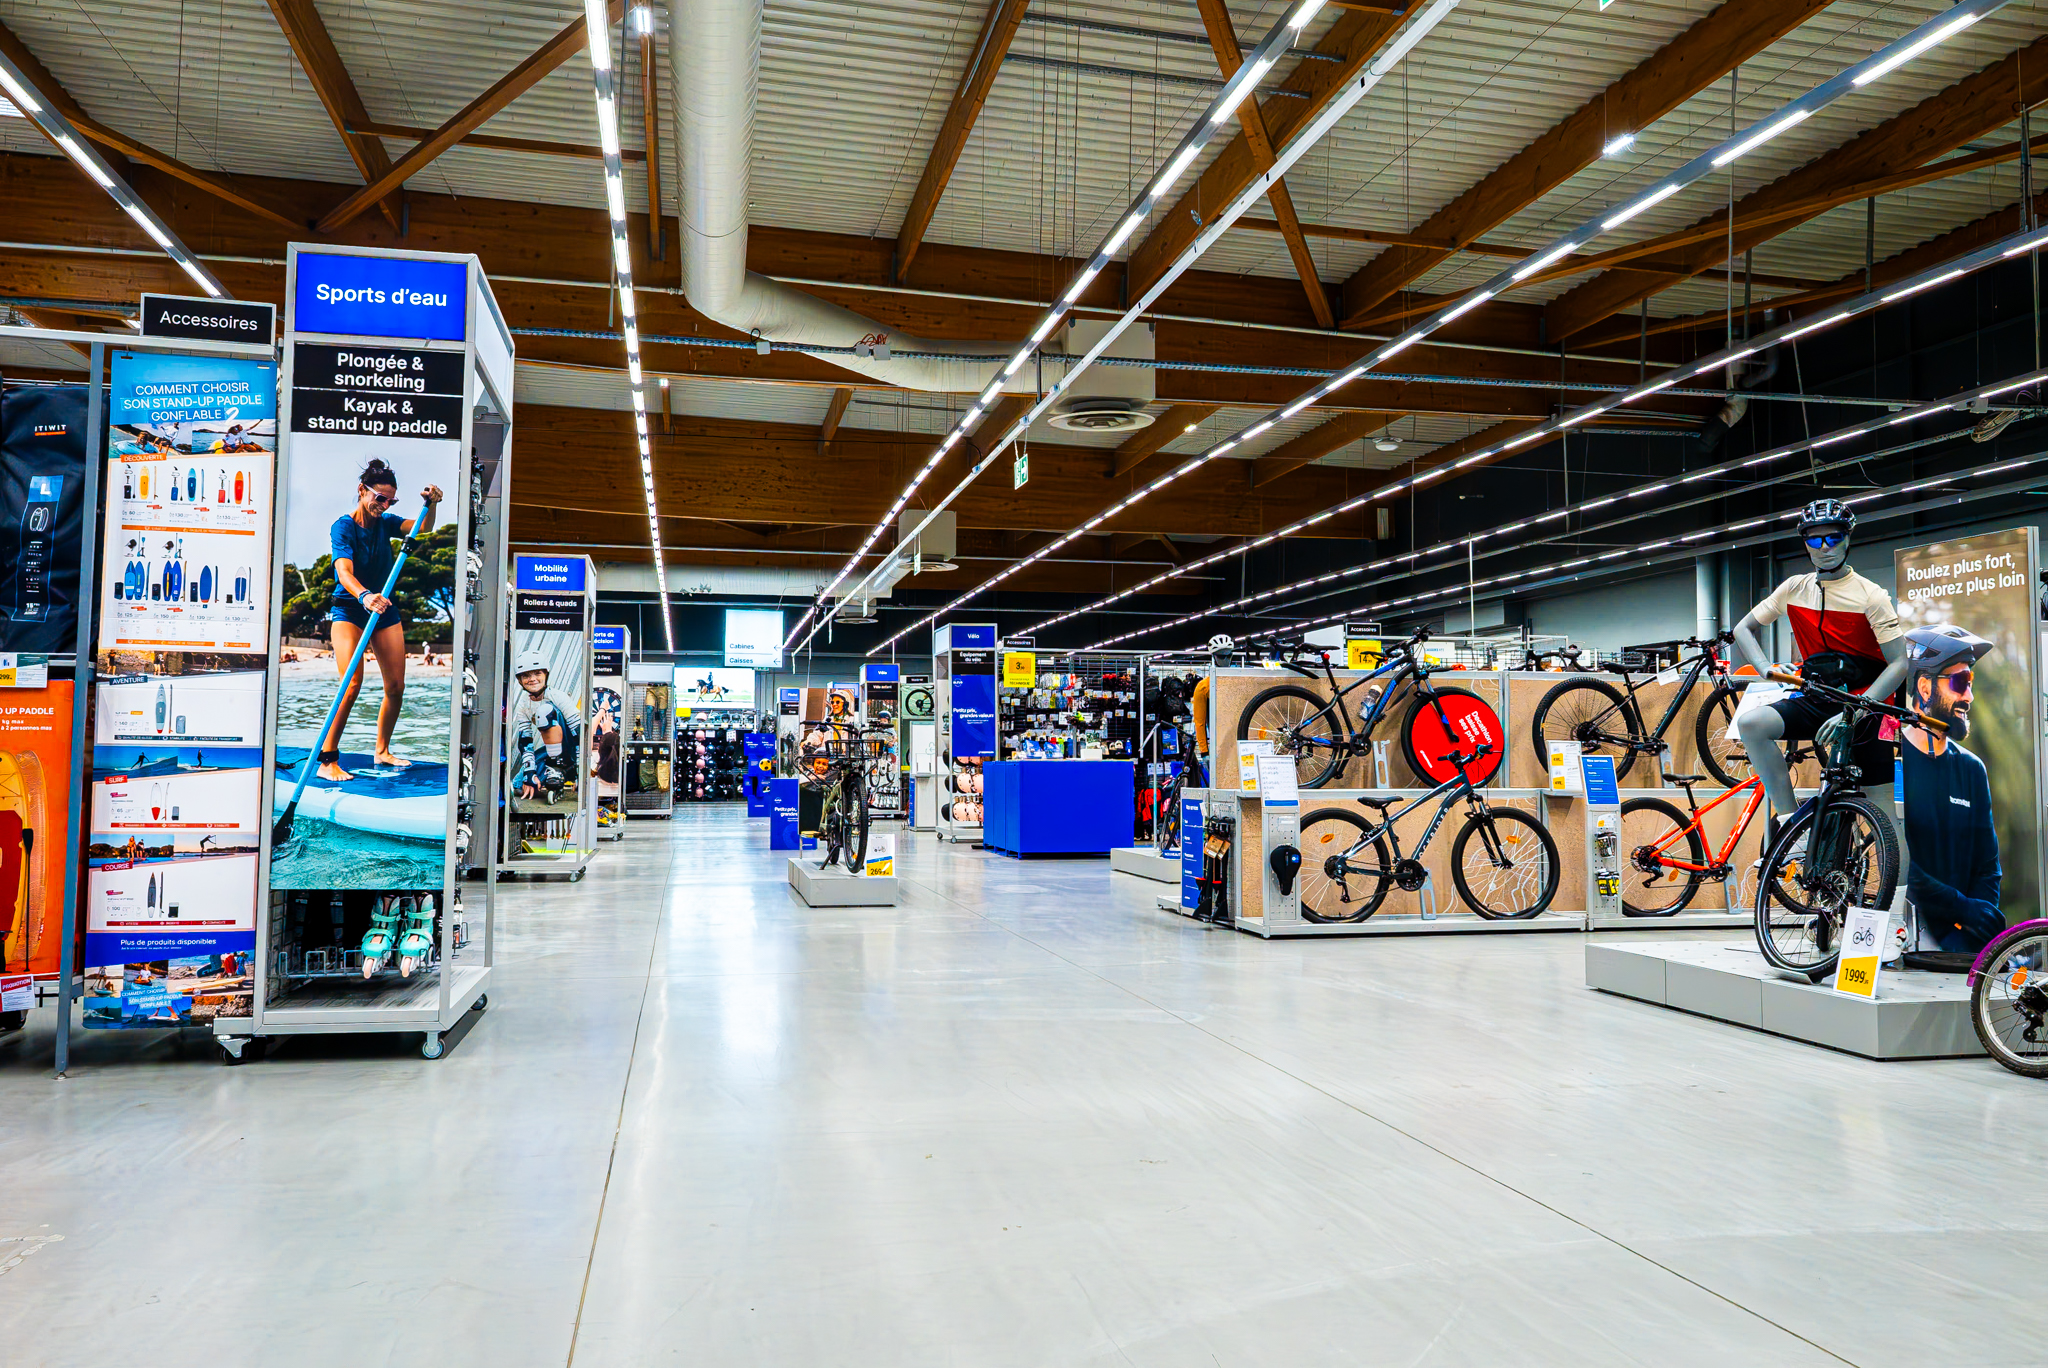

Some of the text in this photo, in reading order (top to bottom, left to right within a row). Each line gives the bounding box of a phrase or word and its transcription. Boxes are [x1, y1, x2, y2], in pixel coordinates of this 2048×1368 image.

[316, 283, 447, 307] Sports d'eau
[159, 310, 258, 331] Accessoires
[337, 353, 424, 372] Plongée &
[135, 382, 250, 396] COMMENT CHOISIR
[334, 373, 425, 392] snorkeling
[124, 394, 262, 410] SON STAND-UP PADDLE
[344, 397, 414, 415] Kayak &
[151, 409, 222, 421] GONFLABLE
[34, 424, 67, 432] ITIWIT
[308, 416, 447, 436] stand up paddle
[40, 483, 51, 495] L
[534, 563, 569, 573] Mobilité
[1906, 552, 2016, 582] Roulez plus fort,
[534, 574, 568, 583] urbaine
[1907, 570, 2025, 600] explorez plus loin
[523, 598, 548, 607] Rollers
[555, 599, 577, 608] quads
[529, 617, 570, 625] Skateboard
[960, 651, 987, 659] Équipement
[112, 676, 145, 685] AVENTURE
[5, 707, 55, 715] UP PADDLE
[1458, 718, 1476, 744] ses prix
[1465, 714, 1480, 736] baisse
[1471, 710, 1492, 744] Decathlon
[109, 776, 125, 784] SURF
[1418, 807, 1449, 858] OCKRIDER
[104, 862, 130, 871] COURSE
[147, 939, 176, 947] produits
[177, 938, 217, 947] disponibles
[2, 978, 31, 990] PROMOTION
